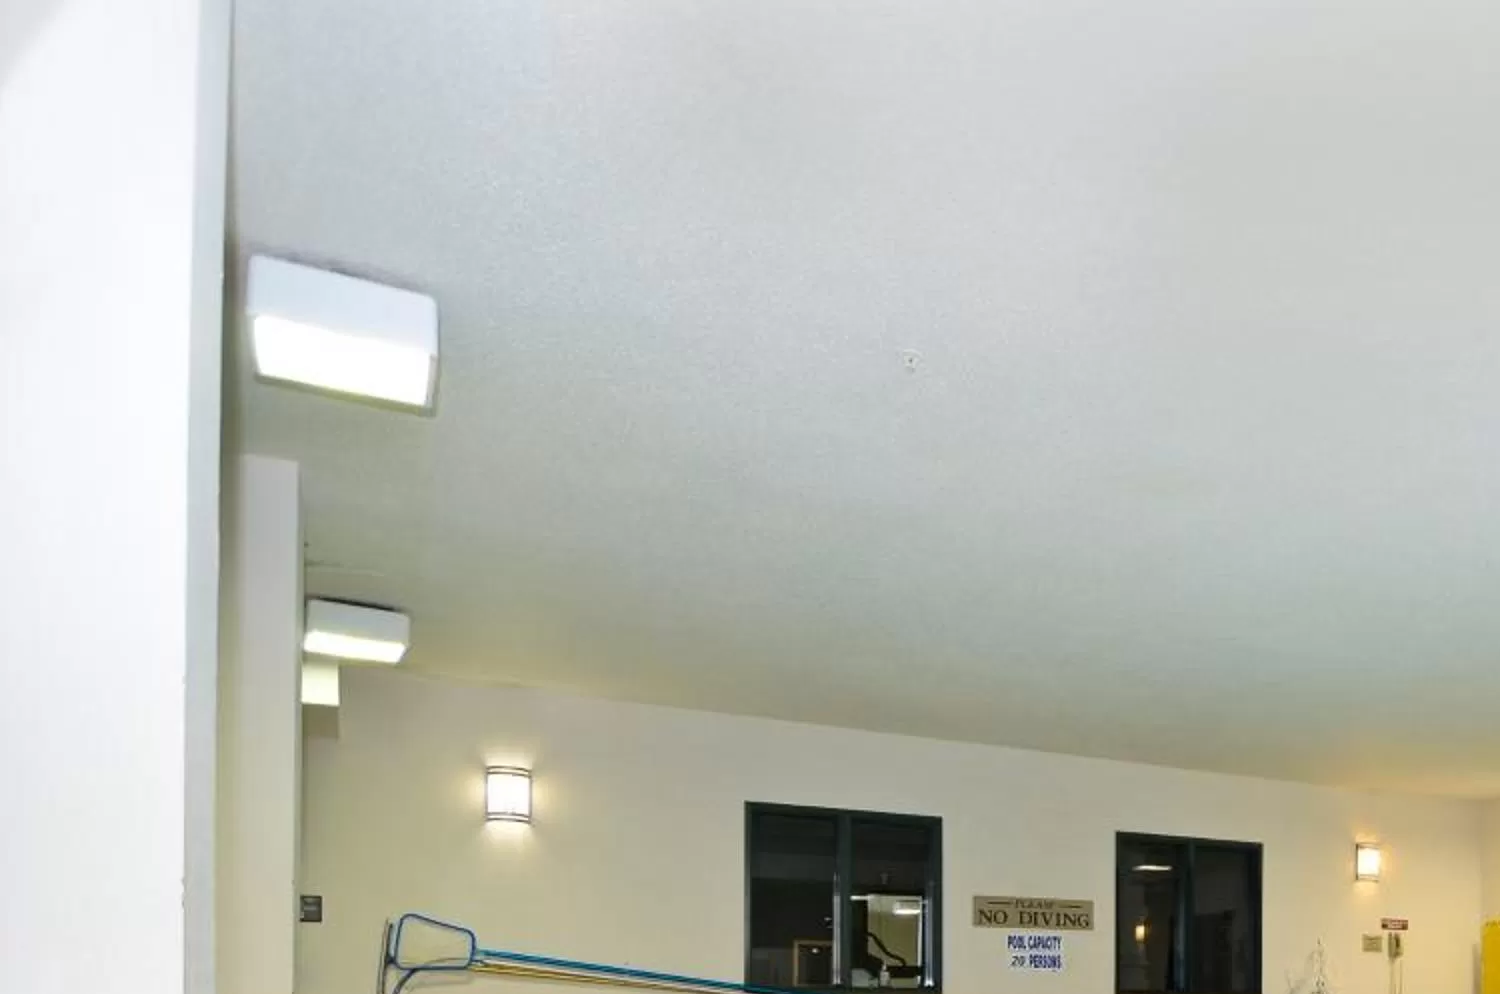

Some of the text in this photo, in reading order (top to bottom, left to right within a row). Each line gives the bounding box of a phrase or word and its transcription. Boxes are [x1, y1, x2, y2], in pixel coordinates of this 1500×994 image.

[978, 909, 1090, 929] NO DIVING
[1007, 935, 1062, 950] POOL CAPACITY
[1029, 954, 1061, 969] PERSONS
